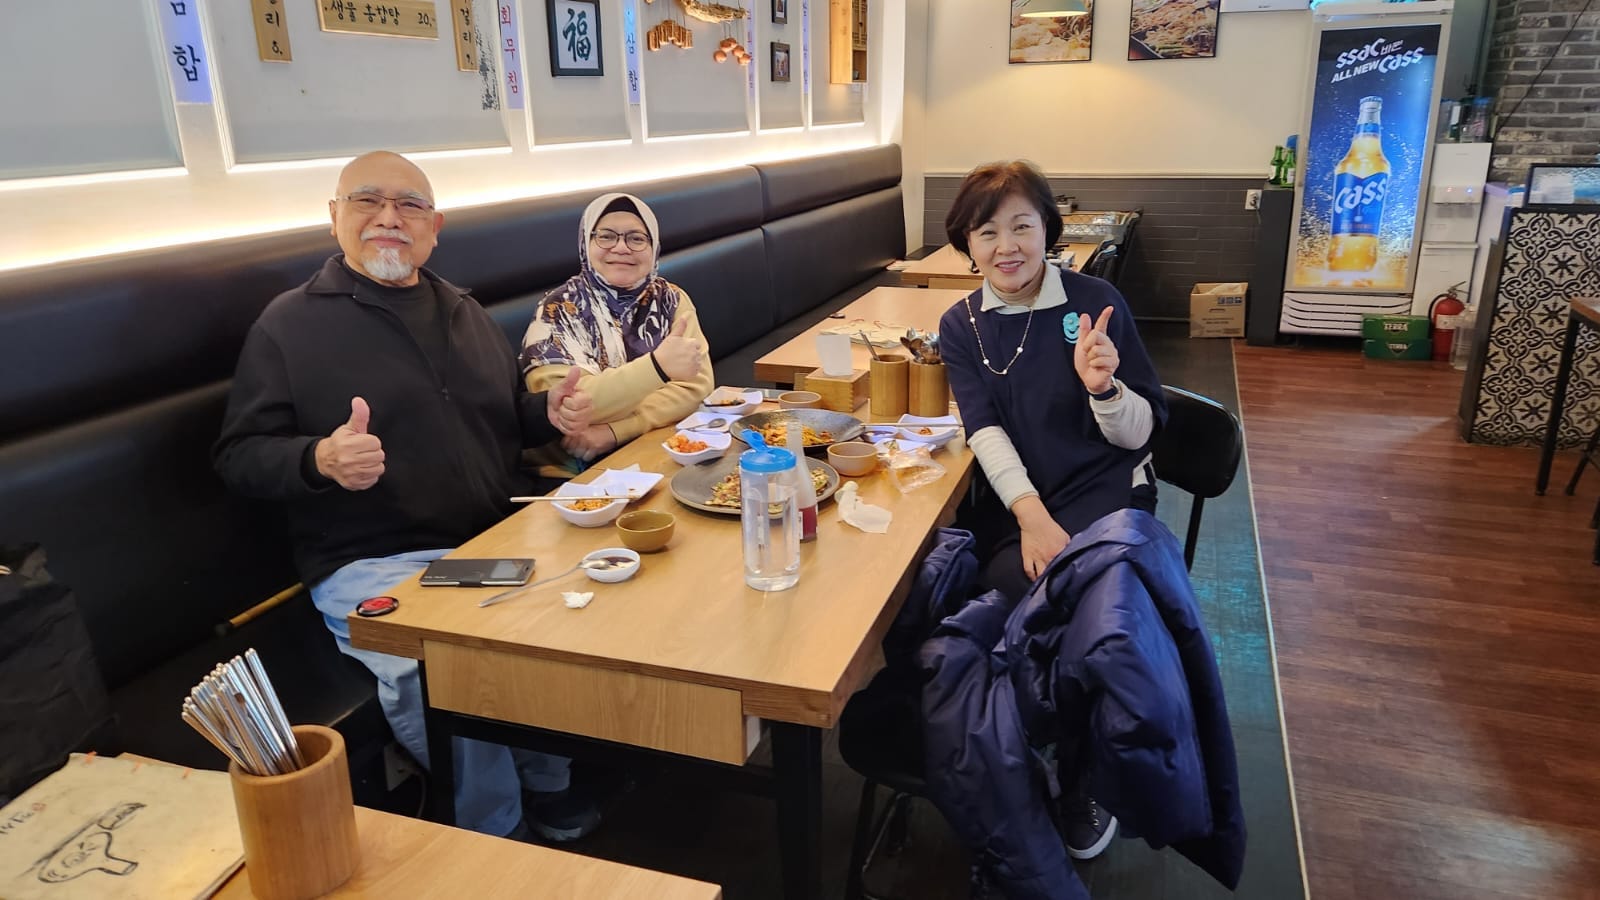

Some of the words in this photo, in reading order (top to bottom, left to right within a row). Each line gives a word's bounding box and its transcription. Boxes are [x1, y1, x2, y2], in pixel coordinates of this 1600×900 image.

[363, 3, 401, 25] 홍합탕
[563, 8, 591, 62] 福
[1331, 69, 1353, 83] ALL
[1353, 59, 1380, 76] NEW
